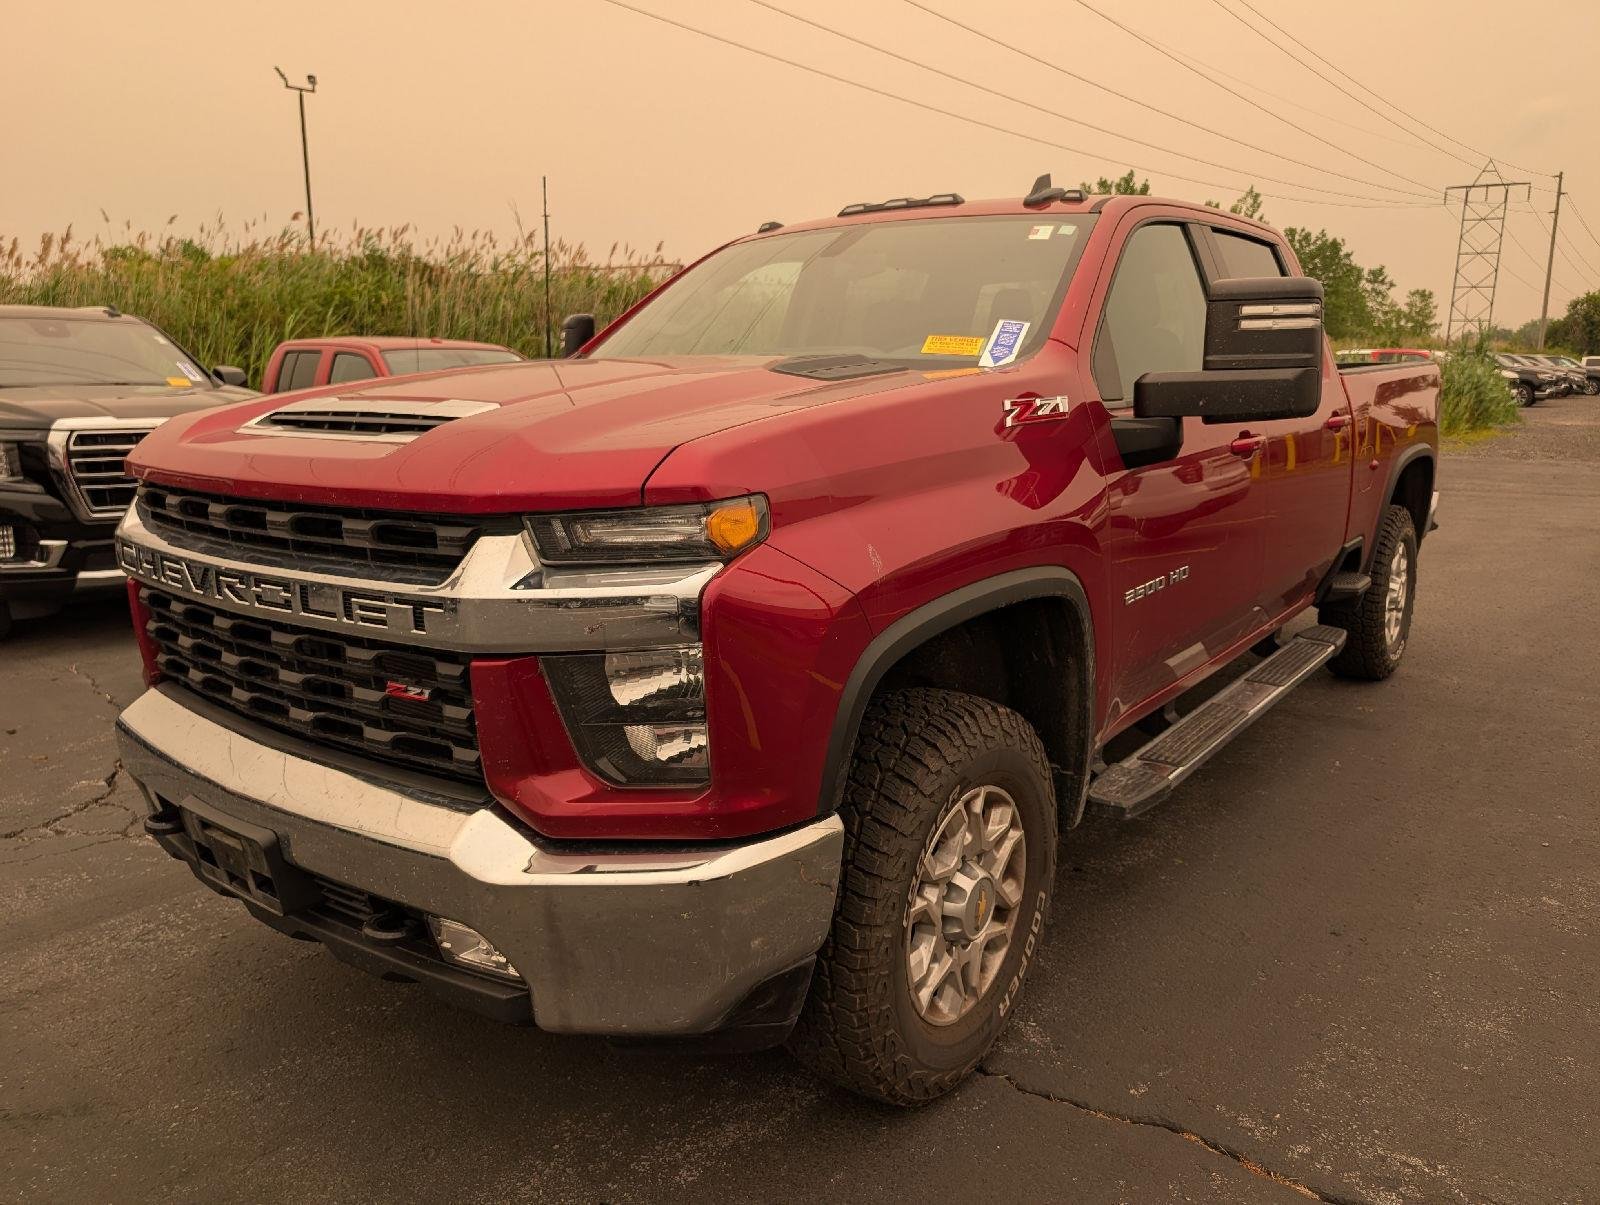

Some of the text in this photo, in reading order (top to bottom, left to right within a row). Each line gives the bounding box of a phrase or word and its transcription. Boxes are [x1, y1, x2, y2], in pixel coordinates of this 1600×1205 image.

[1002, 396, 1069, 428] Z71
[117, 541, 445, 635] CHEVROLET
[1169, 565, 1189, 585] HD
[999, 891, 1045, 1017] COOPER
